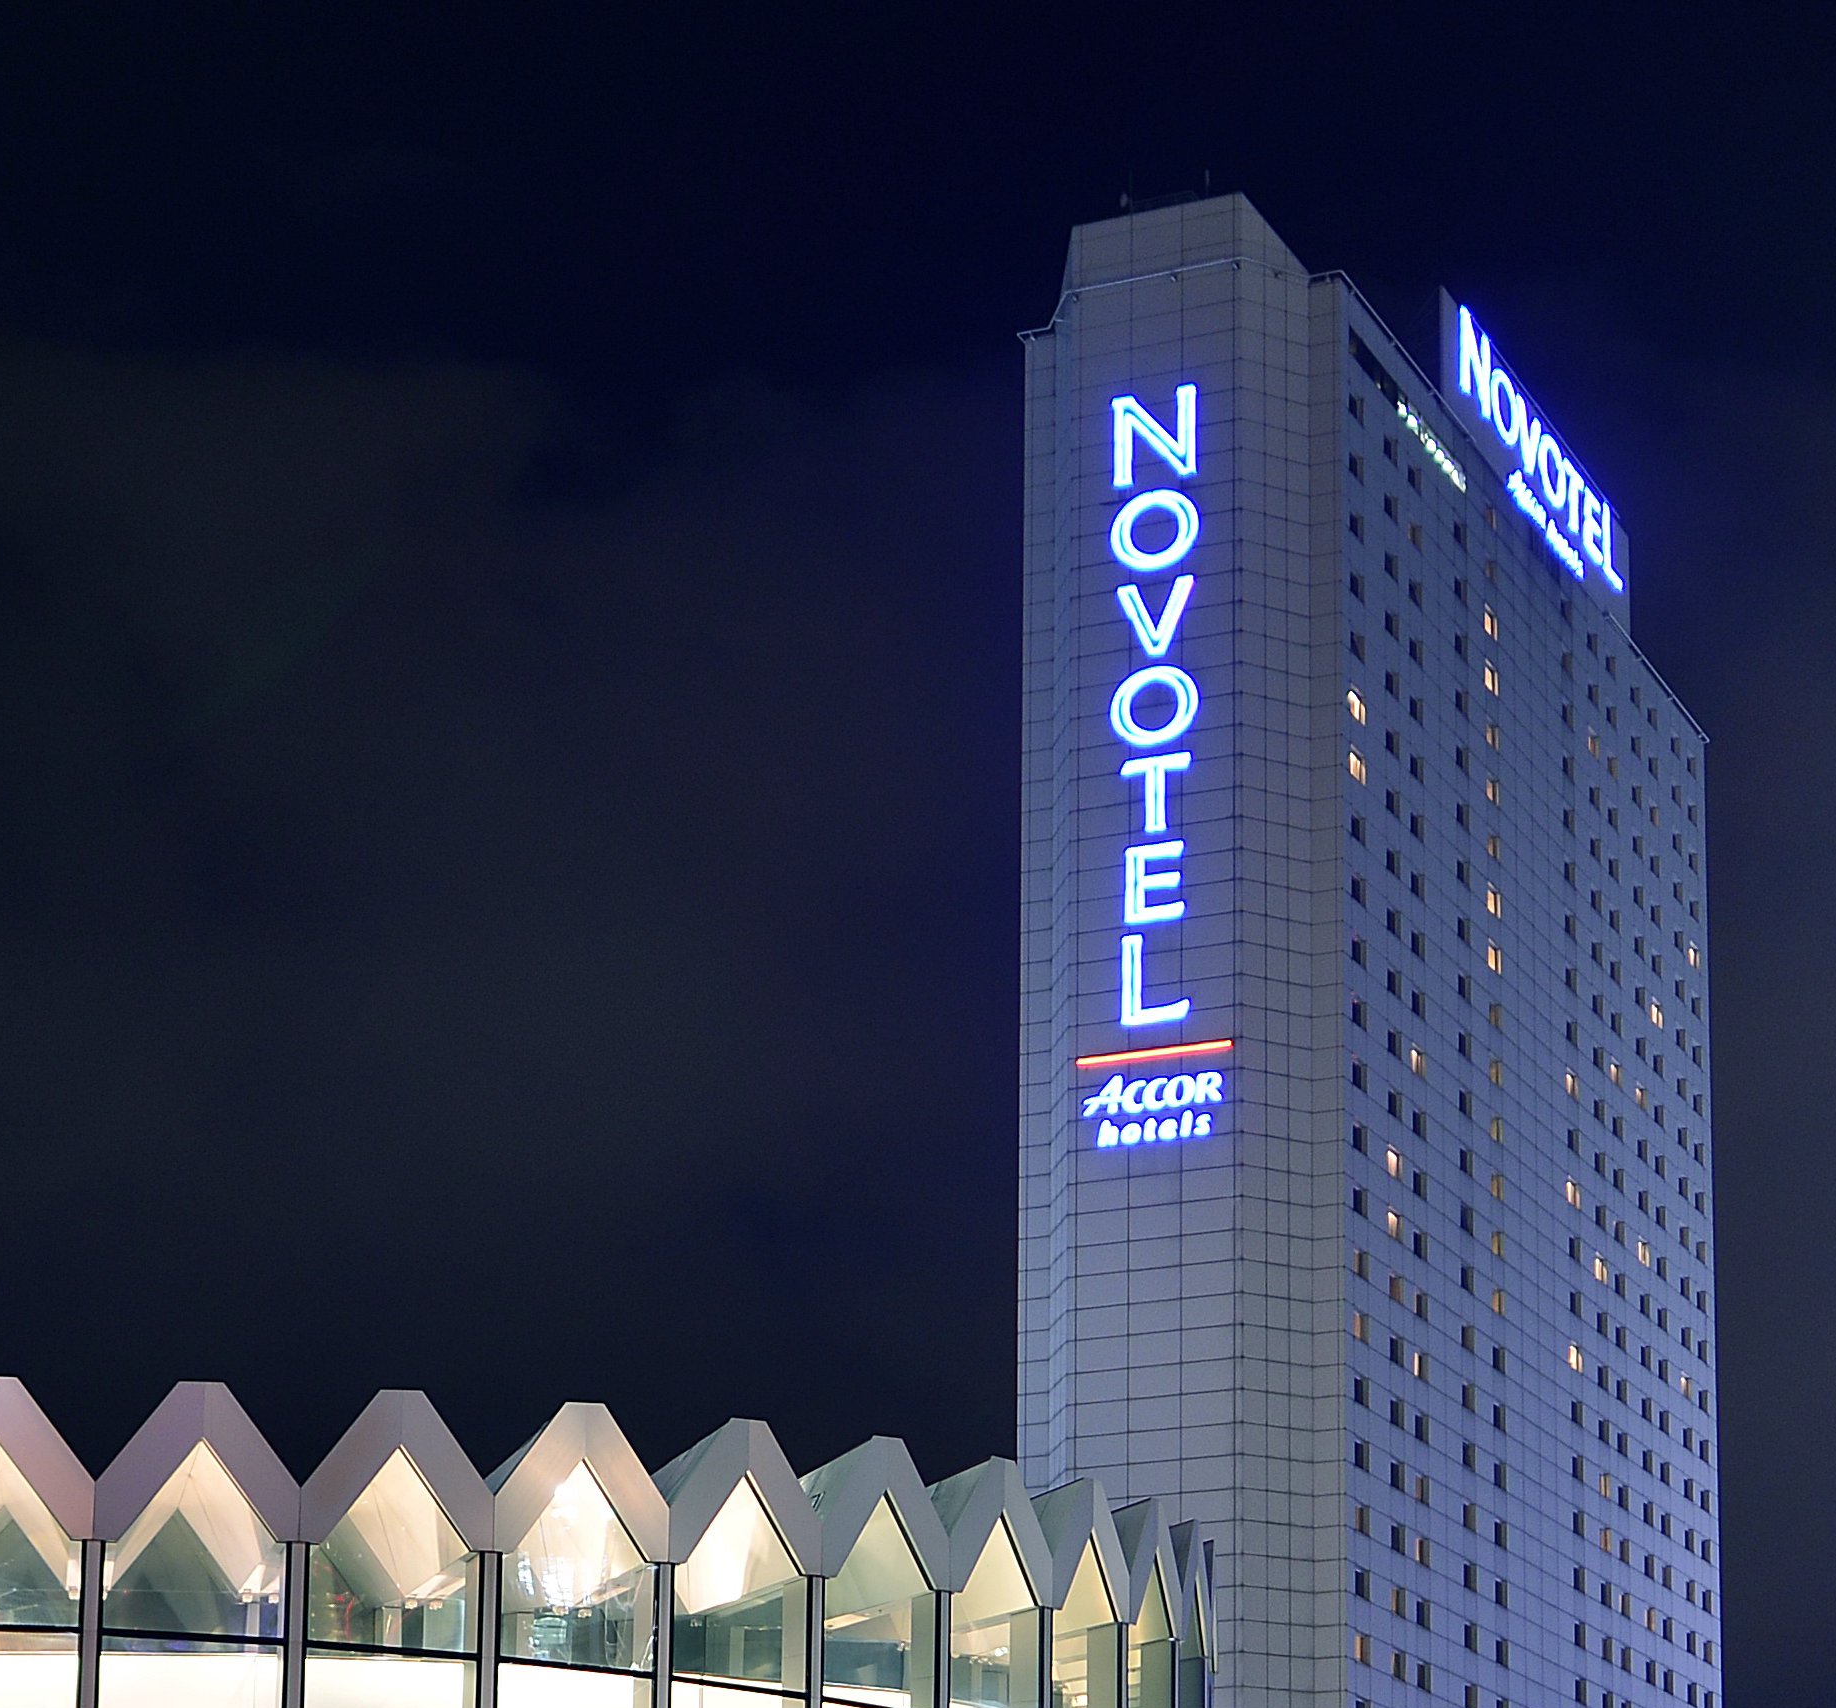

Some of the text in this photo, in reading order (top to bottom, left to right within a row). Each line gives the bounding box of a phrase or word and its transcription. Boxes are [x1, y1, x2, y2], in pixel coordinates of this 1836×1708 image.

[1457, 304, 1625, 592] NOVOTEL
[1108, 383, 1200, 1028] NOVOTEL
[1082, 1070, 1223, 1117] ACCOR
[1096, 1109, 1212, 1148] hotels
